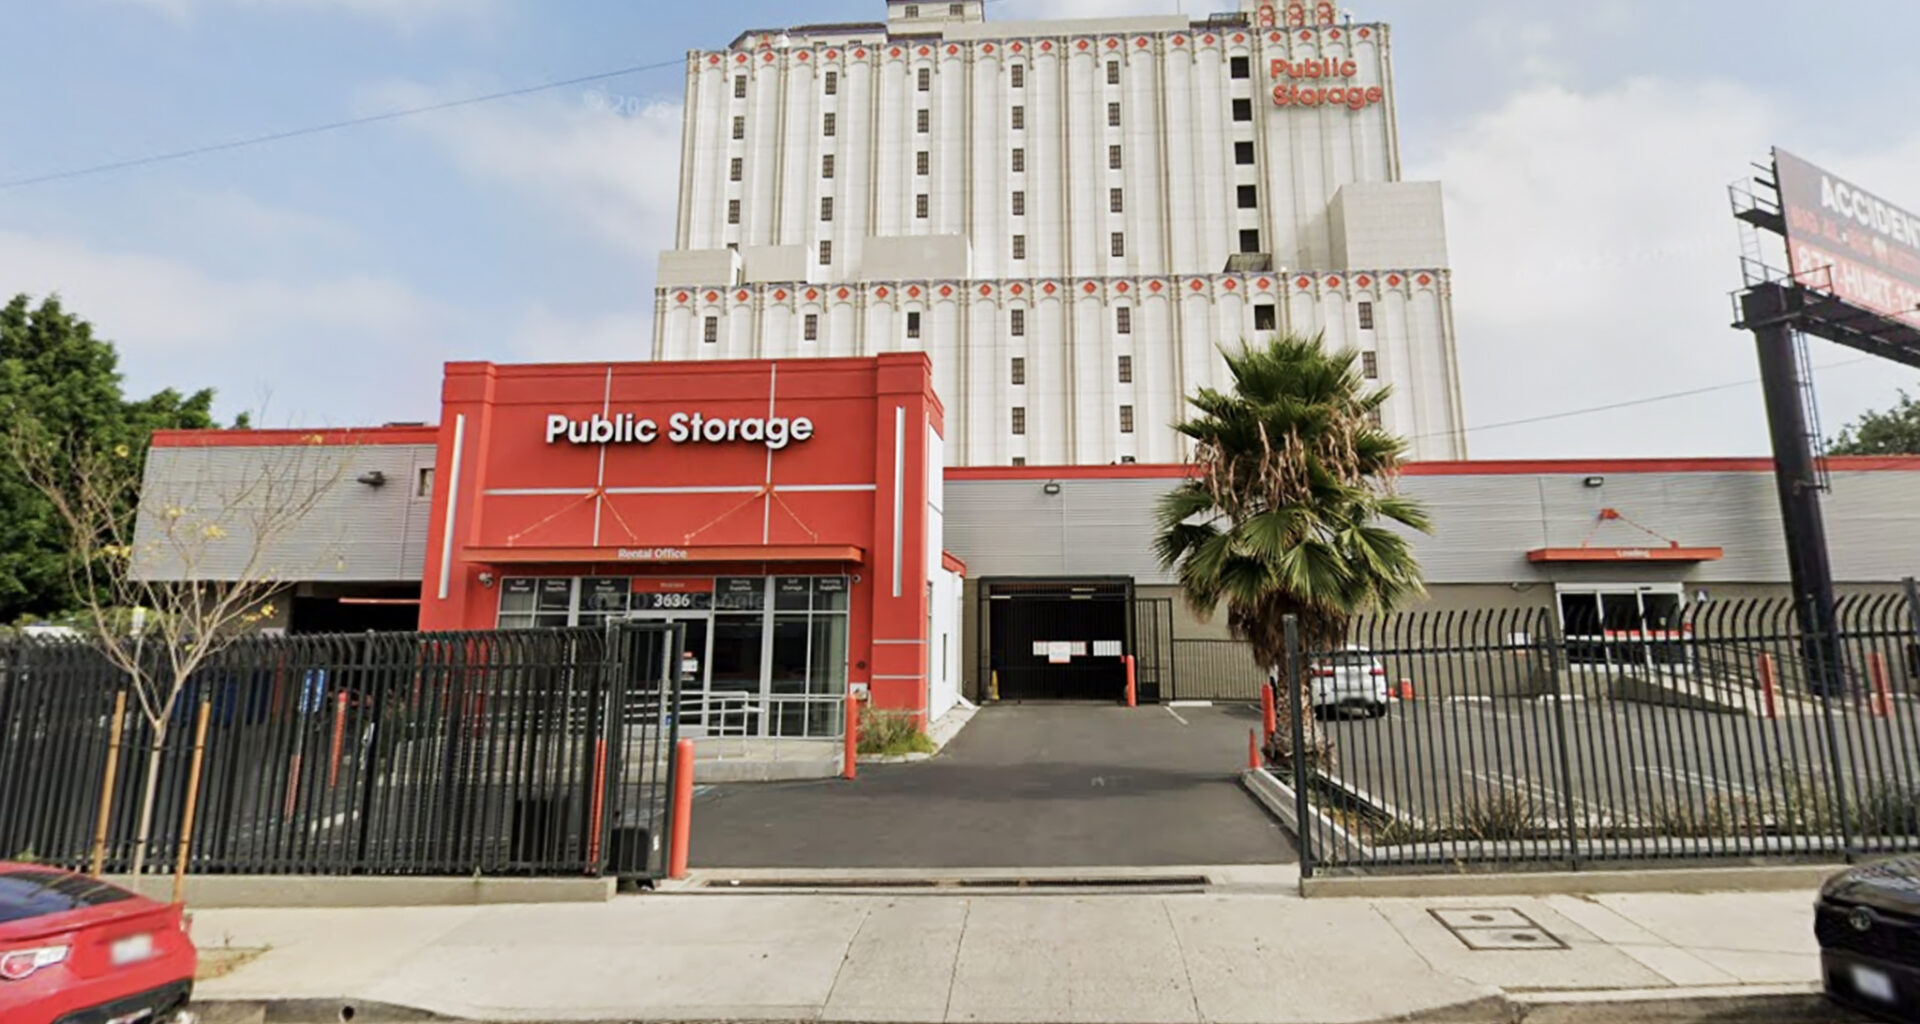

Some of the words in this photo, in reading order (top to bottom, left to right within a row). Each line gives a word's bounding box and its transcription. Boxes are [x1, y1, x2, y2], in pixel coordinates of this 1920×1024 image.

[1270, 57, 1357, 79] Public
[1272, 84, 1382, 111] Storage
[546, 413, 658, 444] Public
[668, 412, 814, 450] Storage
[618, 548, 652, 560] Rental
[654, 548, 688, 560] Office
[653, 593, 690, 608] 3636
